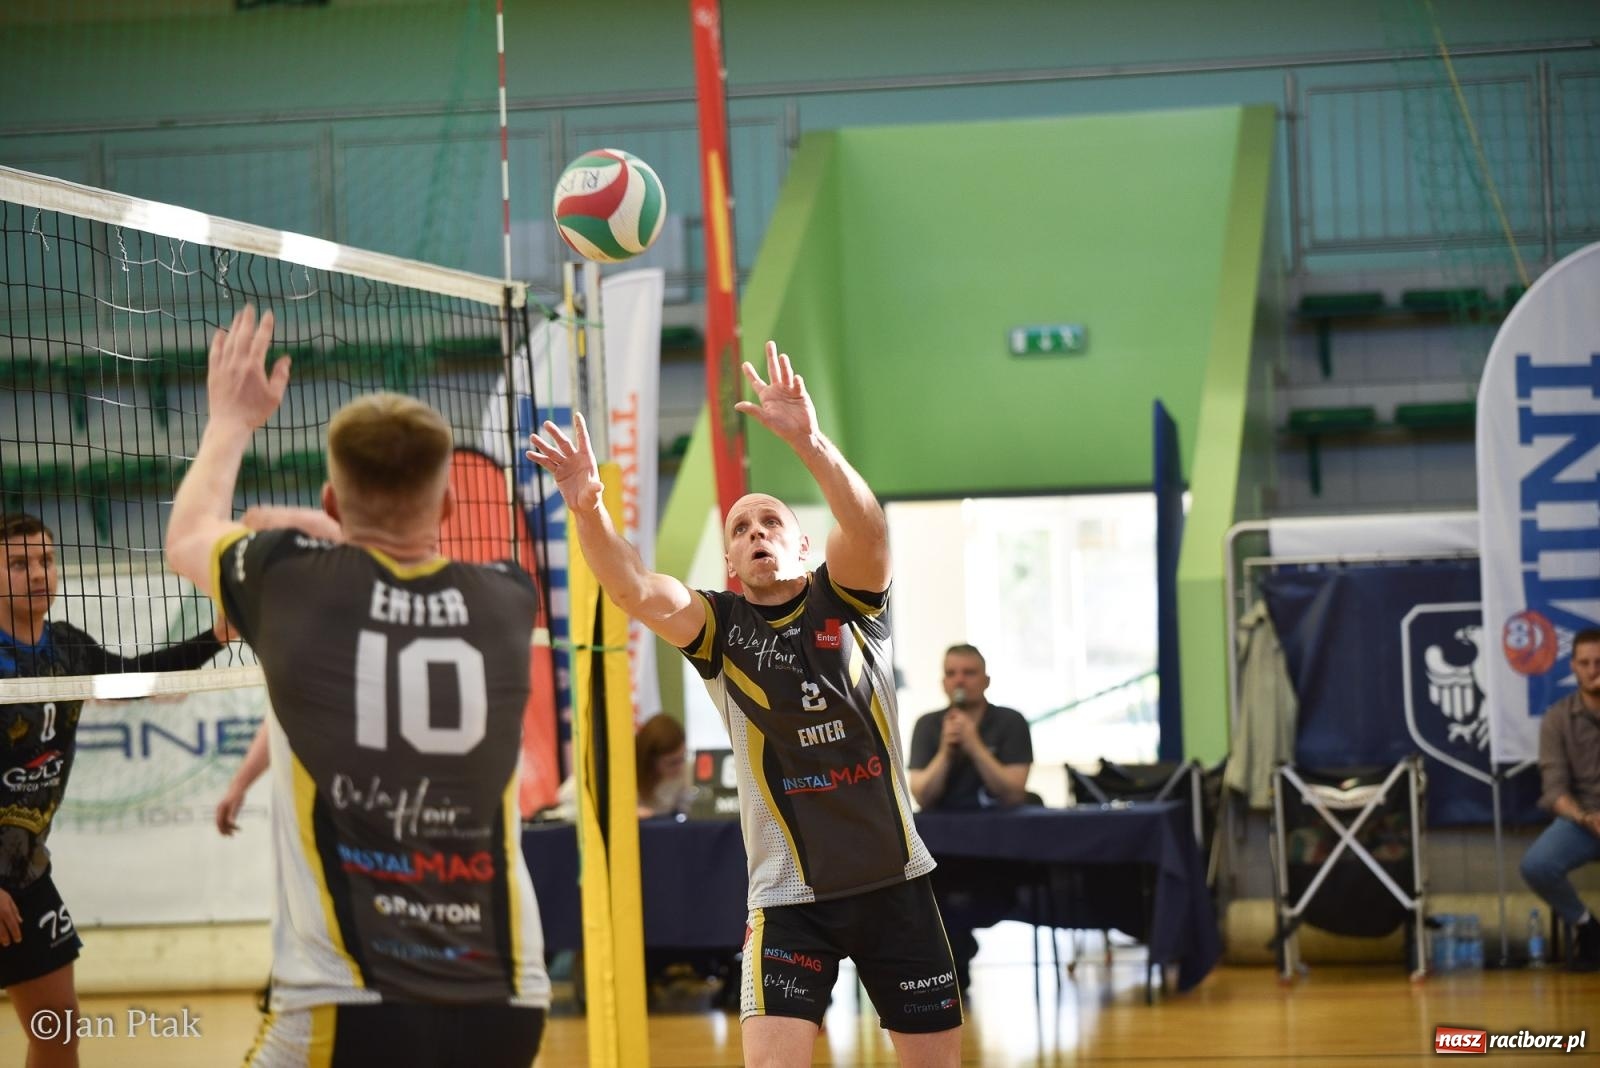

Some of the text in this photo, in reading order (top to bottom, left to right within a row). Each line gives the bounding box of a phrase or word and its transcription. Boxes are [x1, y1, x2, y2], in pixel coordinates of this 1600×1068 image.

[370, 579, 469, 627] ENTER
[816, 632, 839, 643] Enter
[755, 634, 797, 672] Hair
[355, 629, 488, 755] 10
[801, 680, 828, 712] 2
[797, 719, 846, 748] ENTER
[782, 976, 809, 999] Hair
[899, 971, 953, 991] GRAVTON
